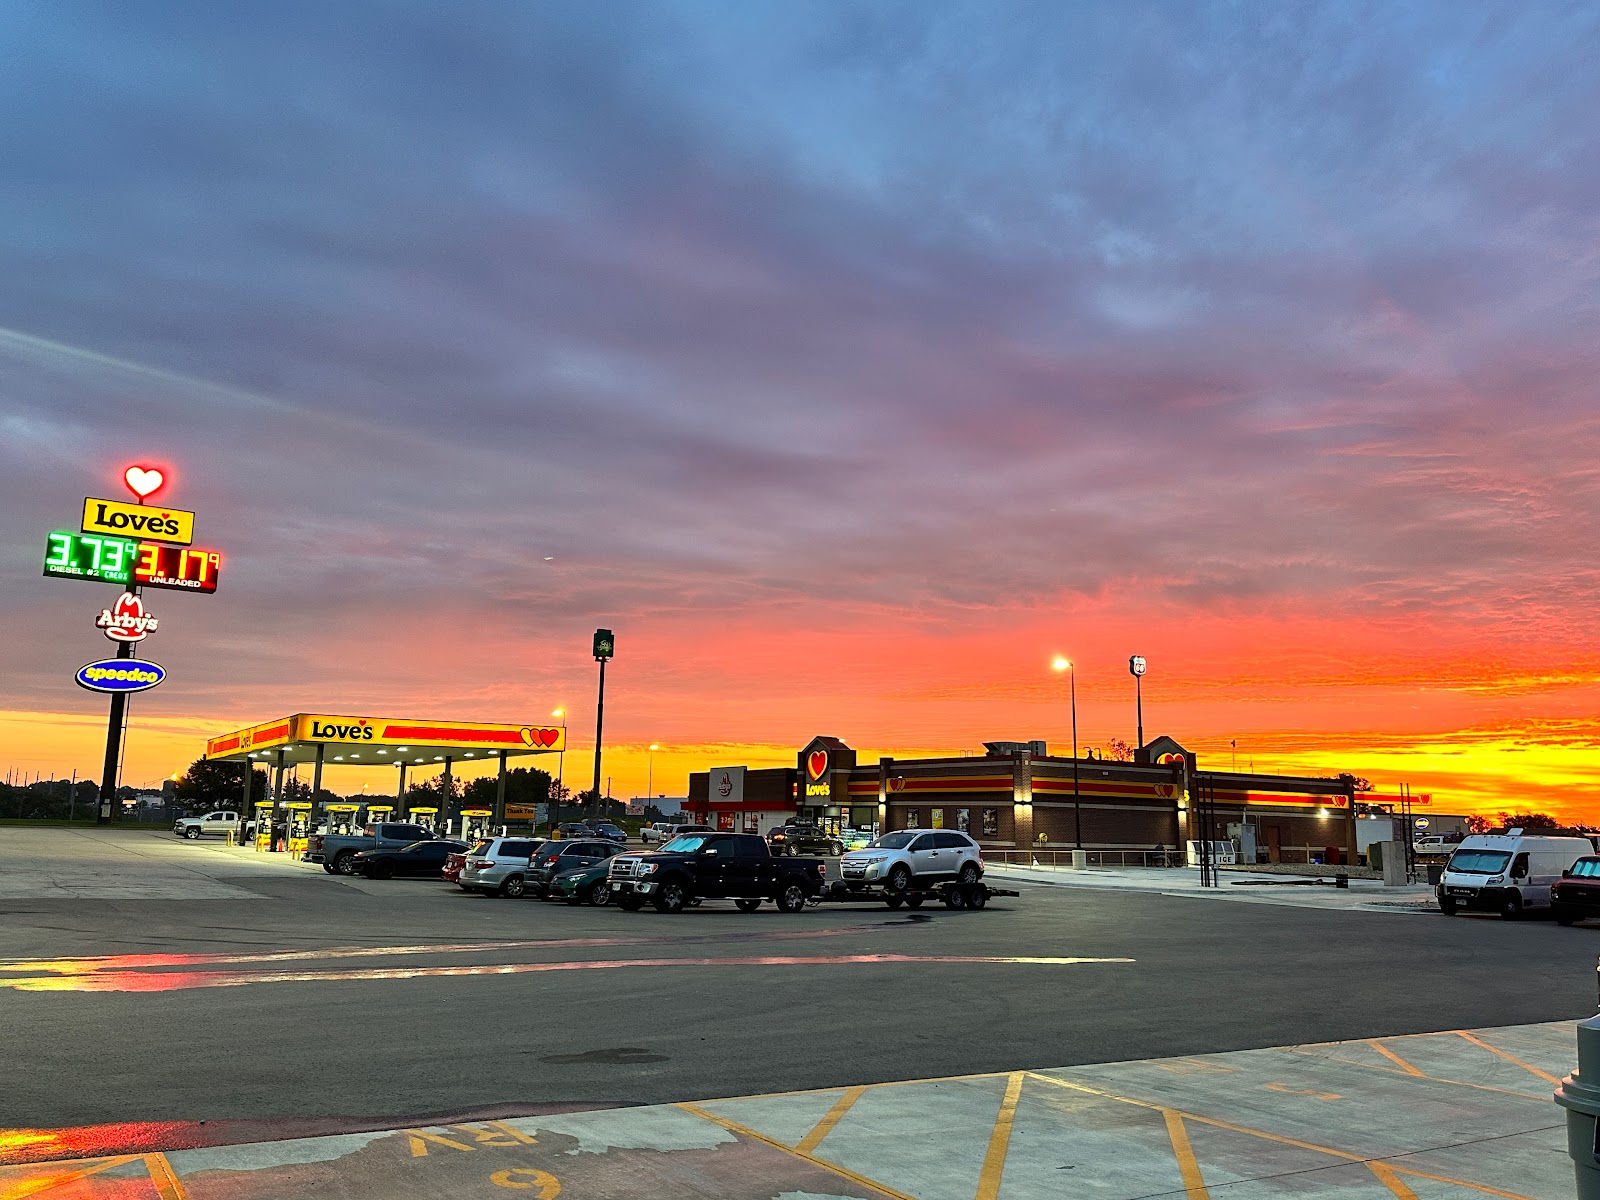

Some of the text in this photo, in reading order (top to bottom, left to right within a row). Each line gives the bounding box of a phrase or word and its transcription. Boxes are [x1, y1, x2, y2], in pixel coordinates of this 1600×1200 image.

[49, 565, 83, 575] DIESEL
[86, 569, 99, 577] #2
[149, 576, 201, 588] UNLEADED
[97, 609, 159, 633] Arby's
[84, 667, 158, 683] speedco
